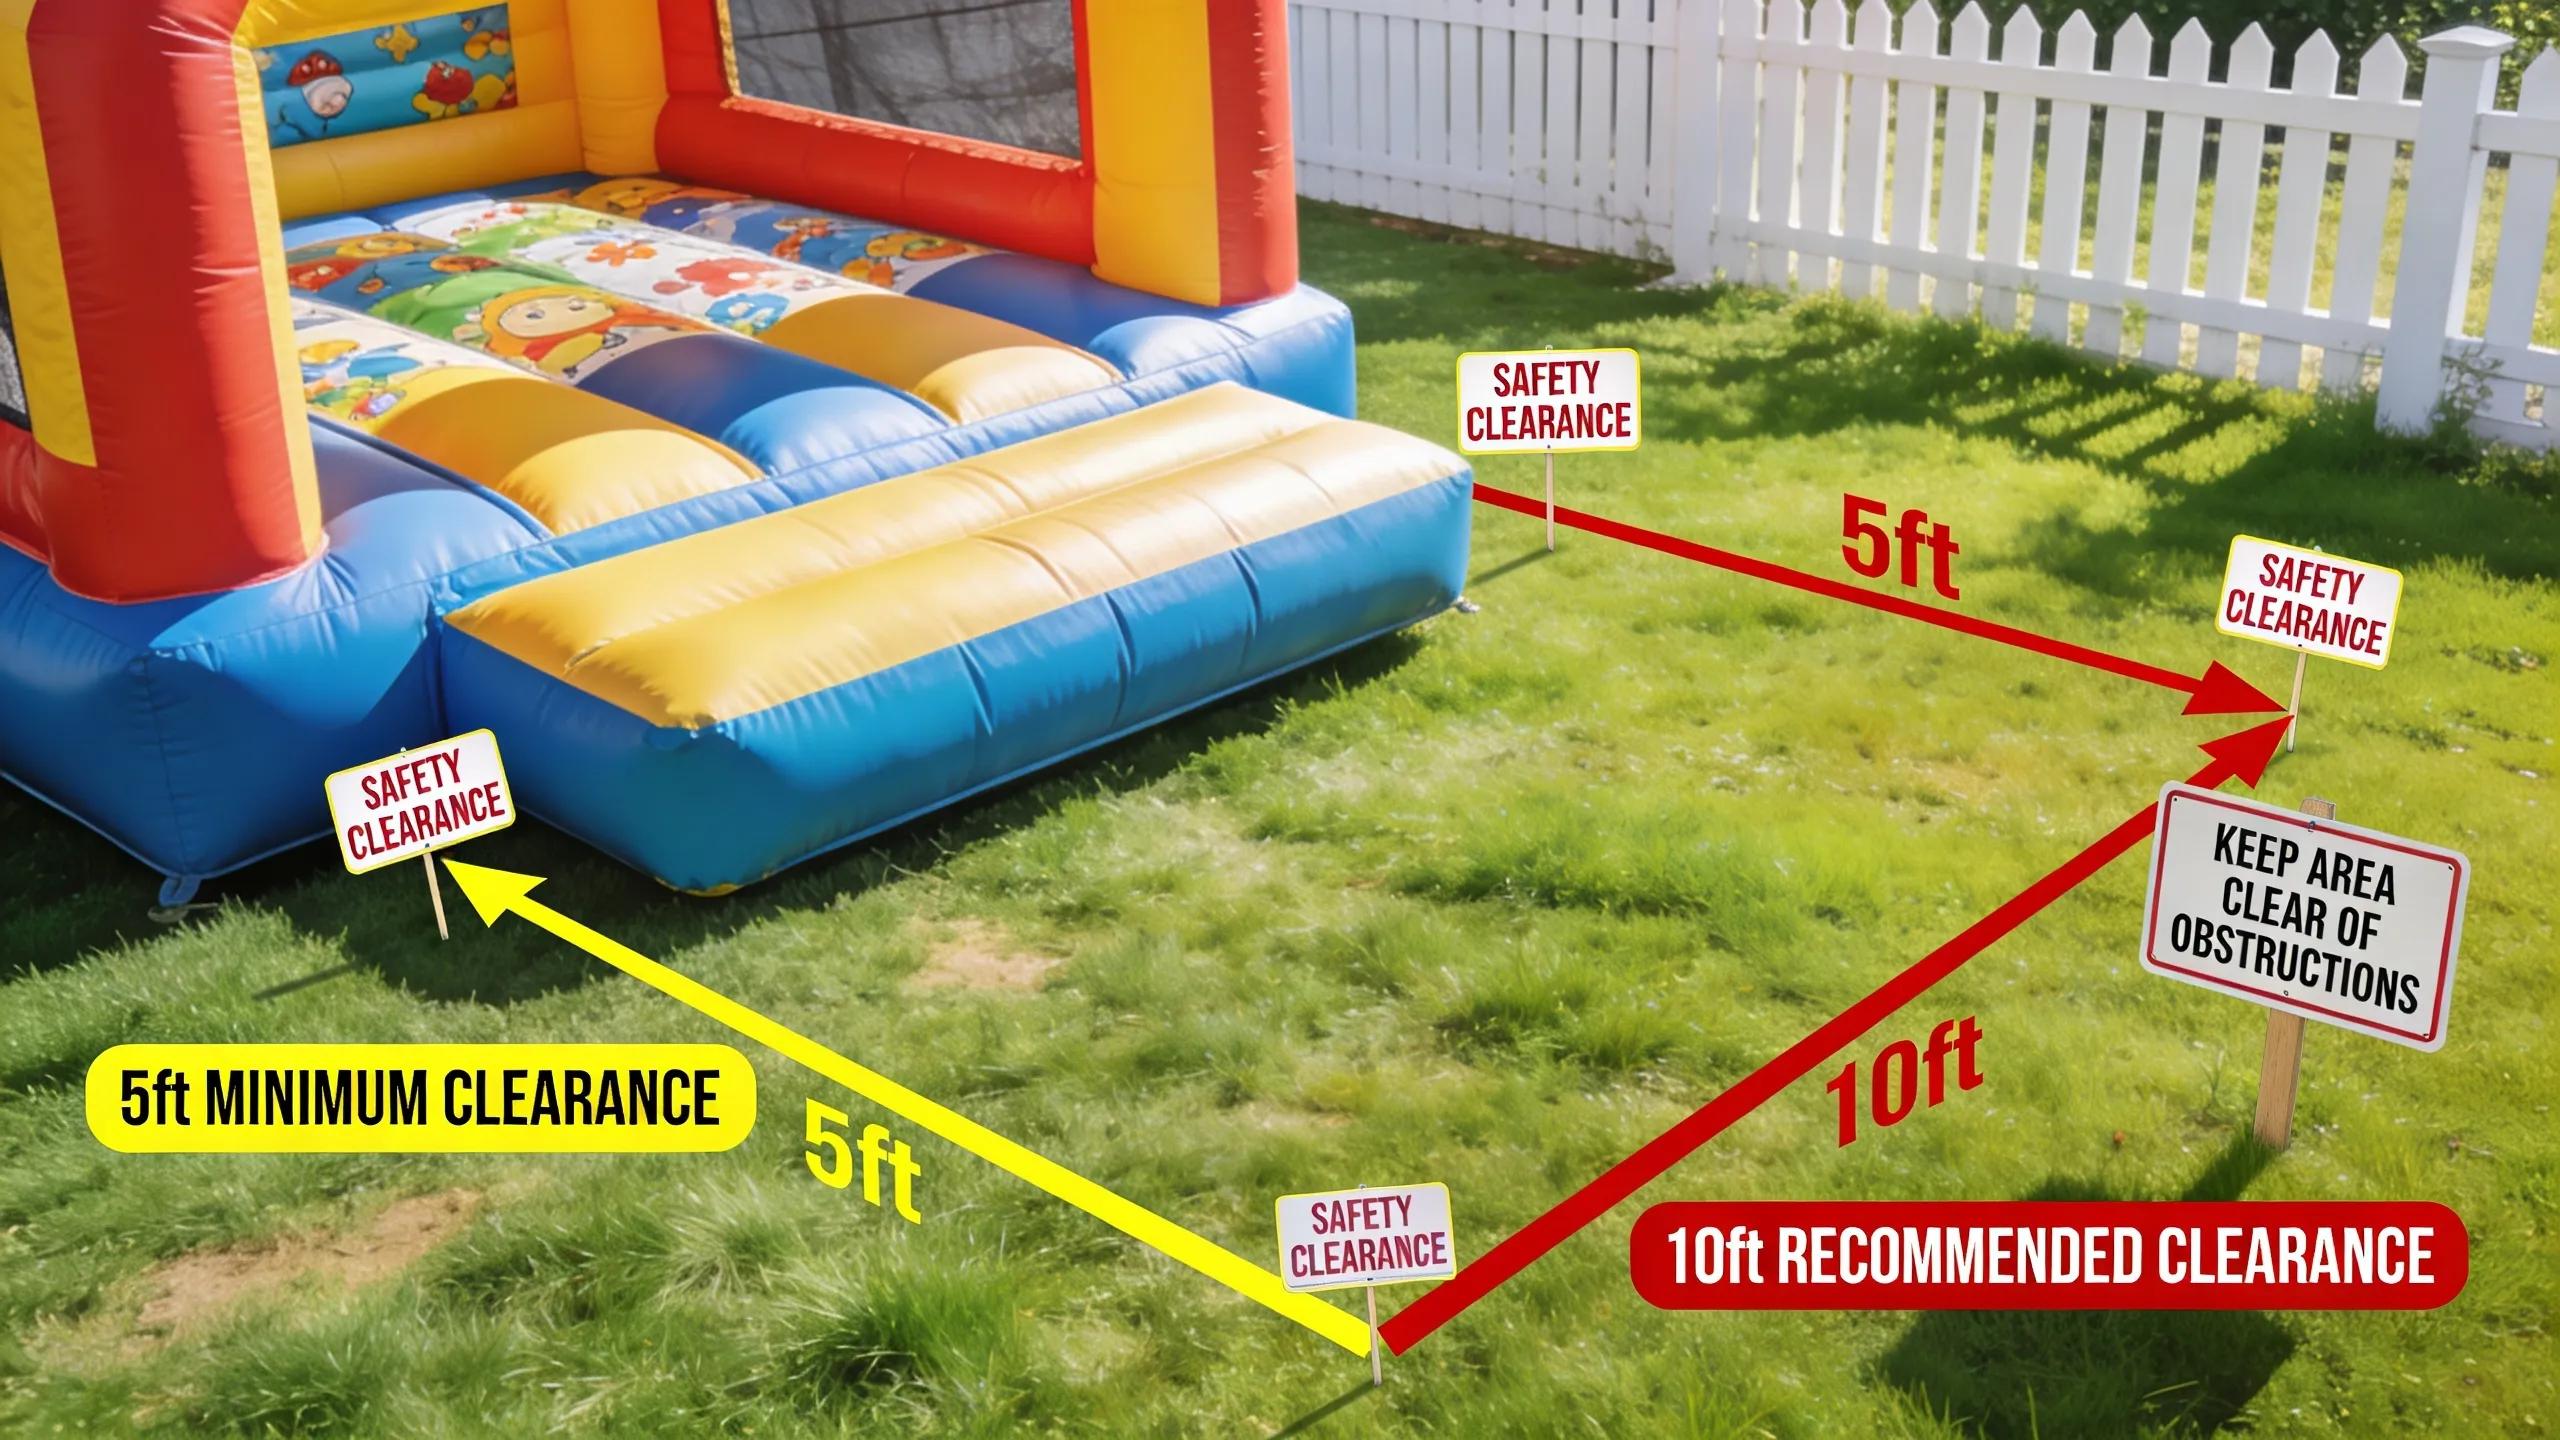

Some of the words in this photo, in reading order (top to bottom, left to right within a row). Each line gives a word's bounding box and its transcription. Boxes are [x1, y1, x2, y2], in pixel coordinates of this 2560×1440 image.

[1493, 360, 1600, 397] SAFETY
[1467, 402, 1631, 442] CLEARANCE
[2259, 553, 2364, 605] SAFETY
[2226, 589, 2387, 656] CLEARANCE
[361, 748, 461, 811] SAFETY
[347, 780, 506, 862] CLEARANCE
[2214, 822, 2300, 878] KEEP
[2306, 848, 2396, 906] AREA
[2222, 876, 2328, 940] CLEAR
[2337, 906, 2382, 950] OF
[2171, 913, 2420, 1016] OBSTRUCTIONS
[1310, 1195, 1413, 1234] SAFETY
[1289, 1233, 1448, 1278] CLEARANCE
